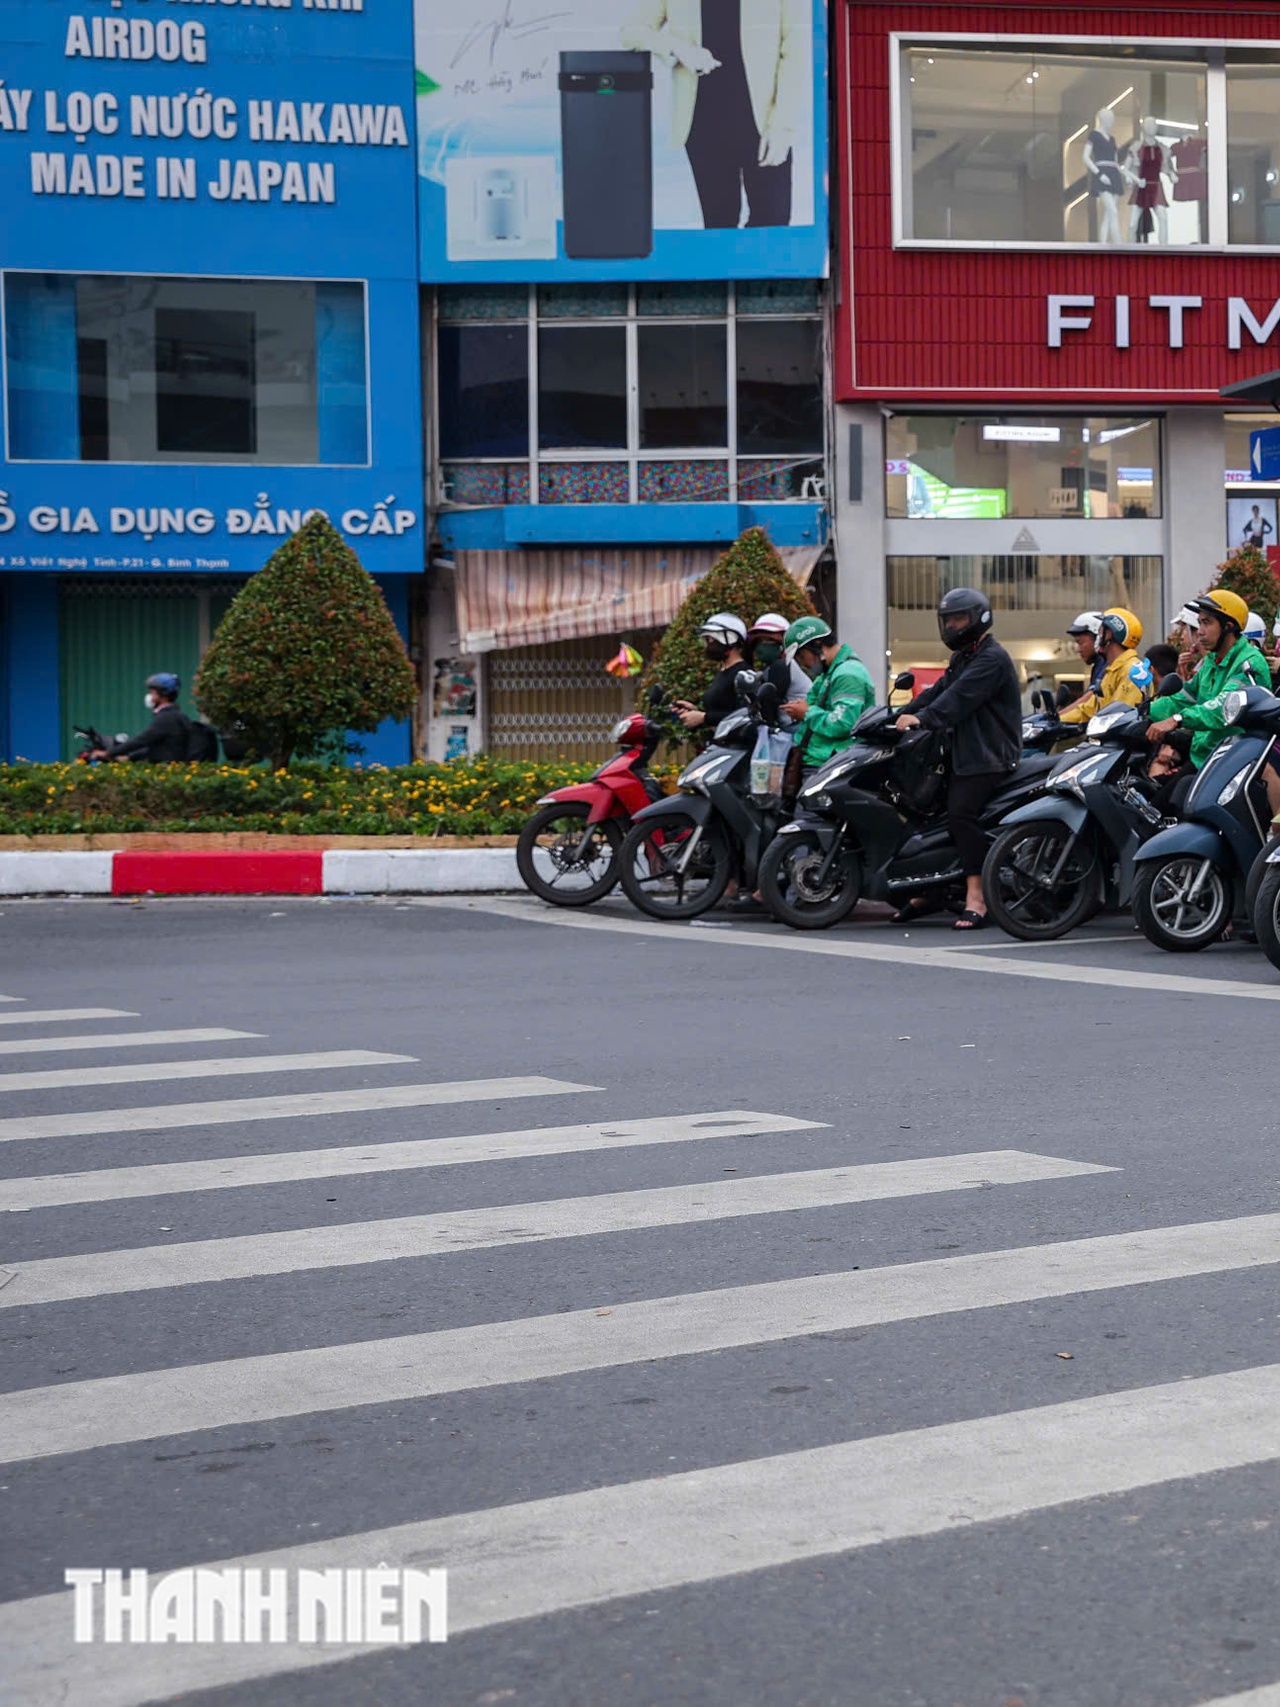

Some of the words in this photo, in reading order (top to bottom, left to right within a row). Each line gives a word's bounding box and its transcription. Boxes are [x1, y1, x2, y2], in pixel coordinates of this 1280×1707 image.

[65, 15, 207, 63] AIRDOG
[45, 92, 119, 142] LỌC
[131, 88, 237, 139] NƯỚC
[249, 101, 409, 146] HAKAWA
[31, 152, 145, 197] MADE
[156, 157, 196, 199] IN
[209, 160, 335, 203] JAPAN
[29, 506, 99, 533] GIA
[111, 507, 215, 541] DỤNG
[342, 494, 416, 535] CẤP
[796, 625, 817, 640] Grab
